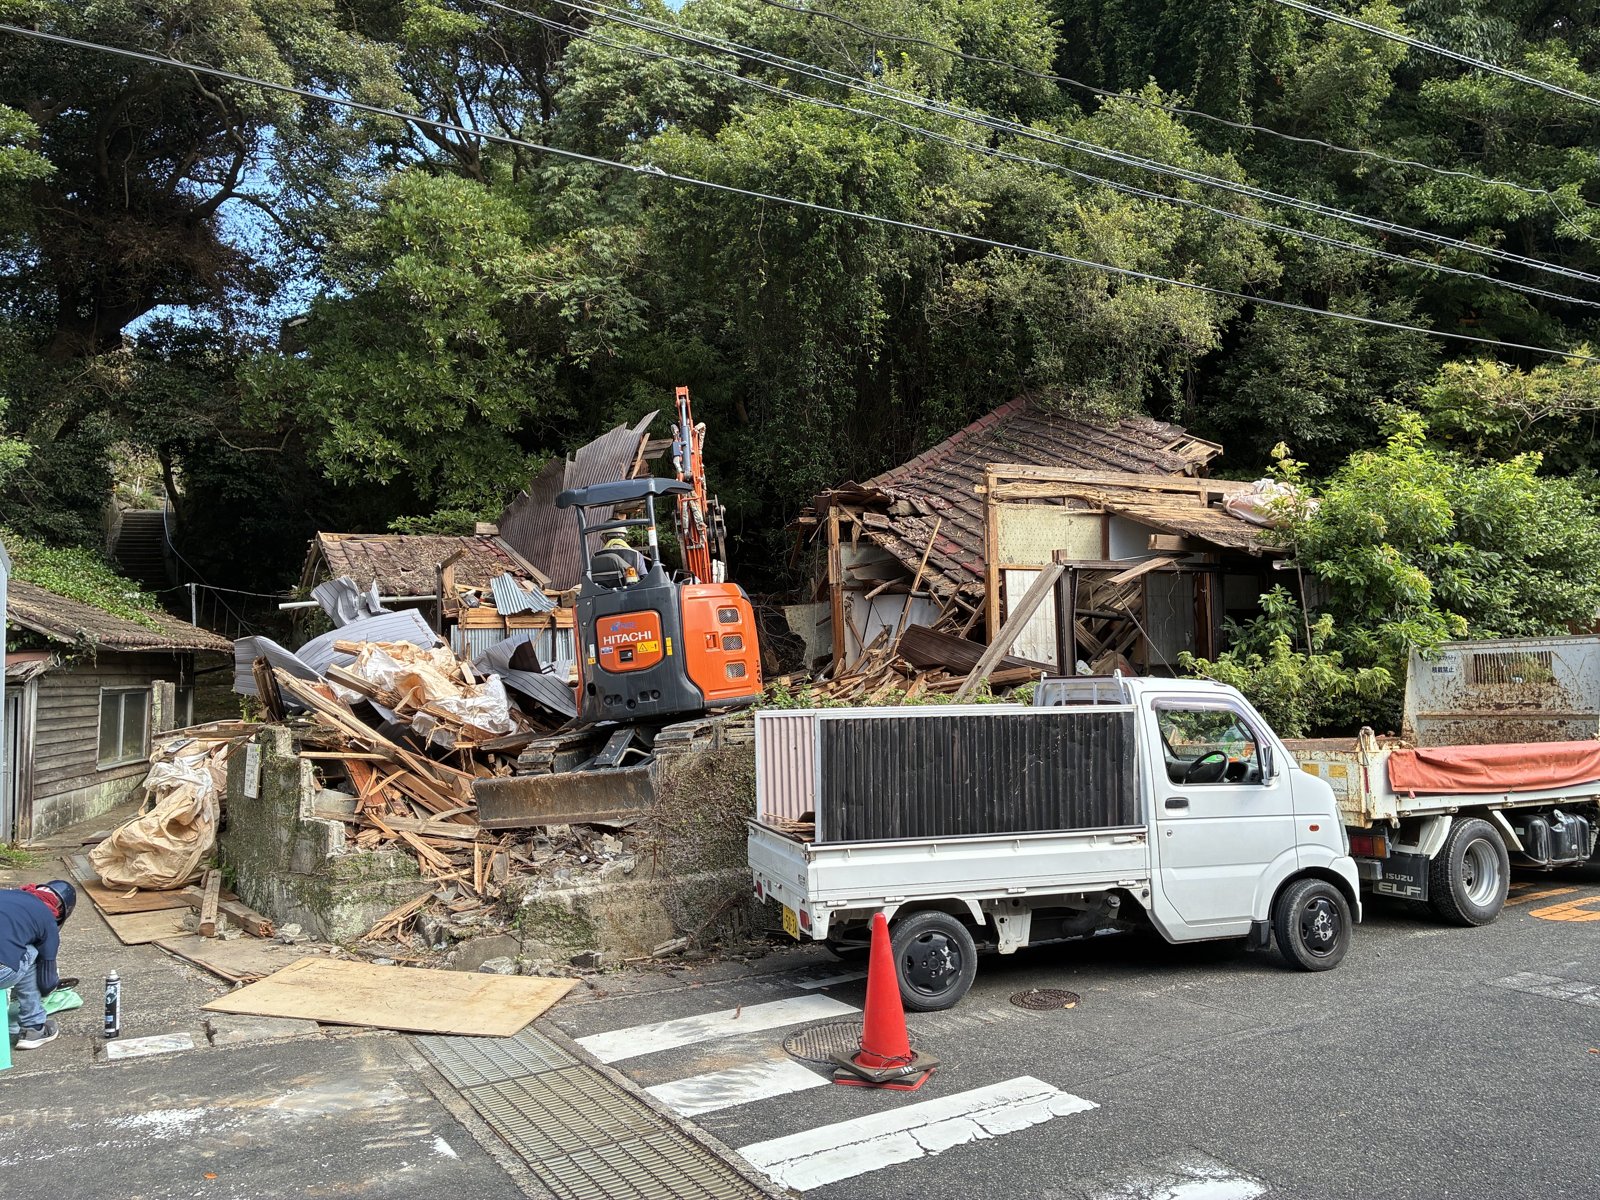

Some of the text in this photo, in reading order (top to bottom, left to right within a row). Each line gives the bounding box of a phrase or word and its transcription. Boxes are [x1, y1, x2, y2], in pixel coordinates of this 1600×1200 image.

[603, 630, 652, 645] HITACHI
[1385, 872, 1414, 882] ISUZU
[1378, 882, 1421, 896] ELF
